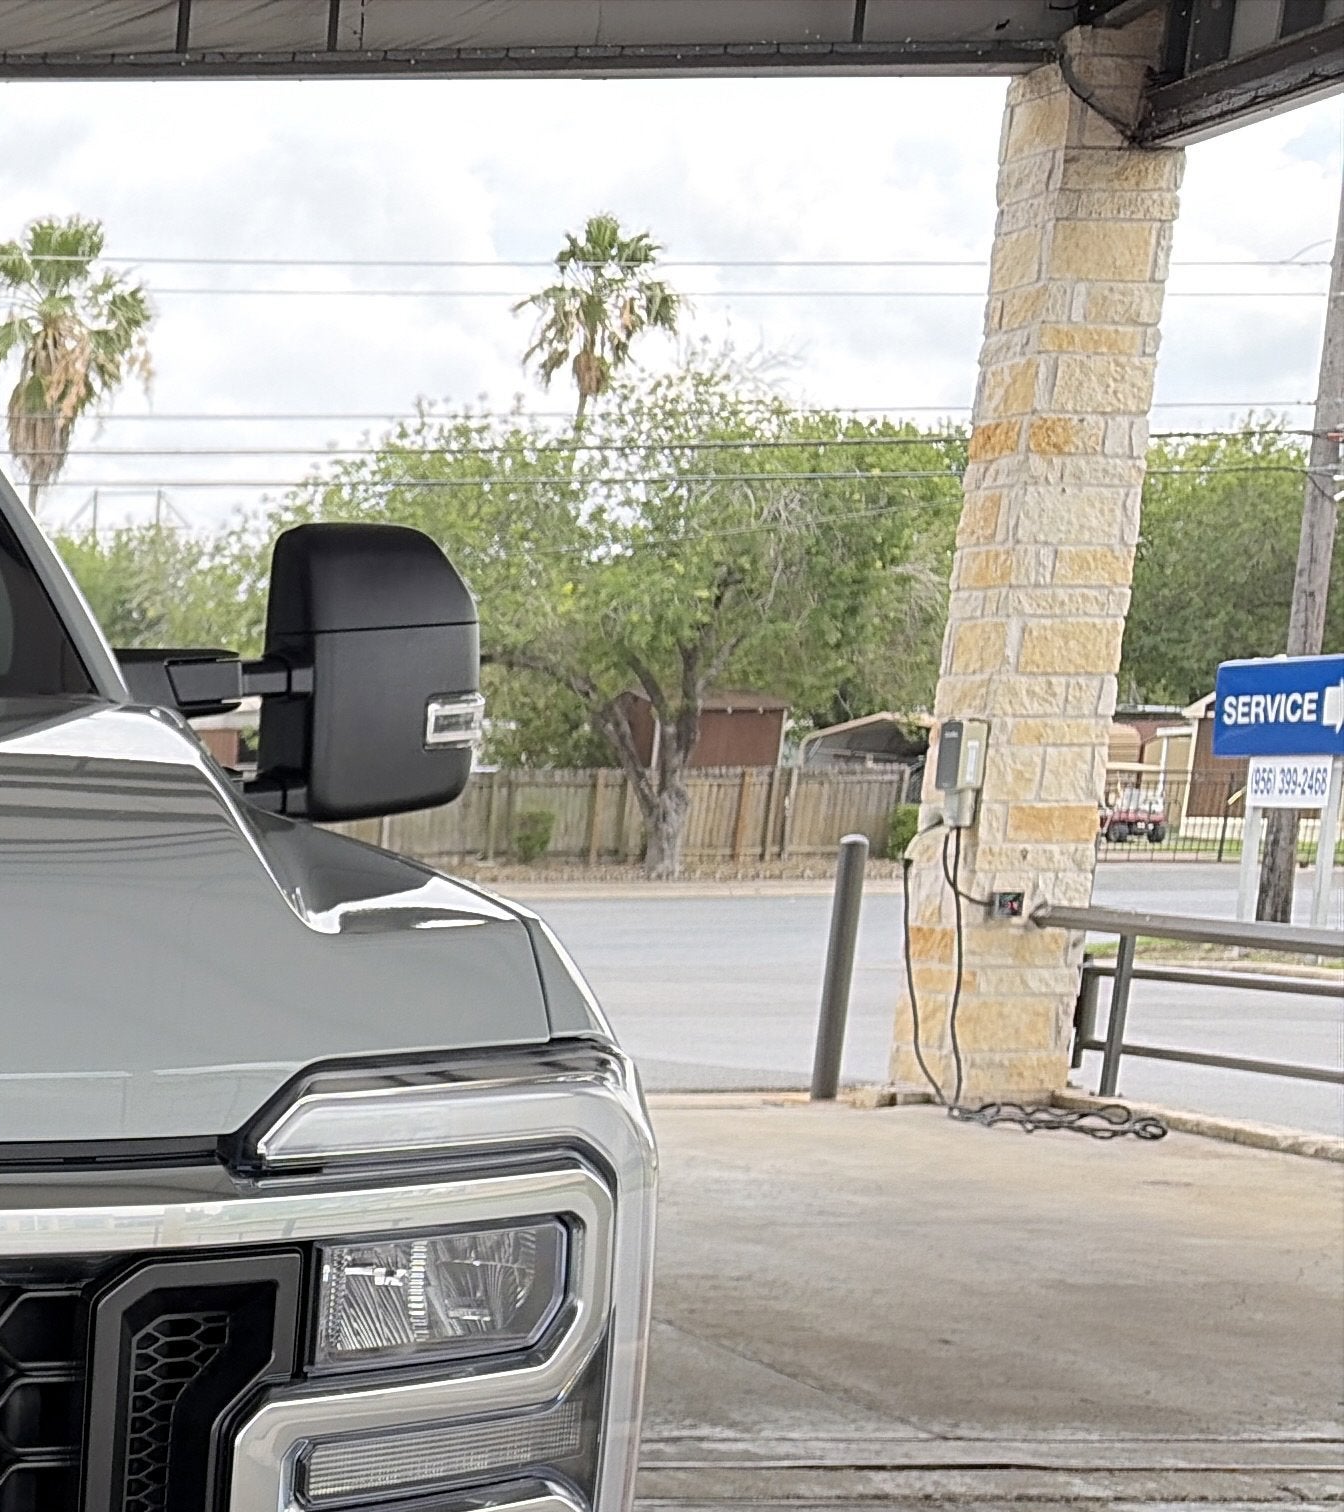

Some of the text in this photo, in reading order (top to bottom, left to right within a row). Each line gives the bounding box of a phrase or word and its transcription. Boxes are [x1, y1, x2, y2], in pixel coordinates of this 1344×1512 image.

[1222, 691, 1319, 725] SERVICE
[1251, 766, 1328, 796] (956) 399-2468
